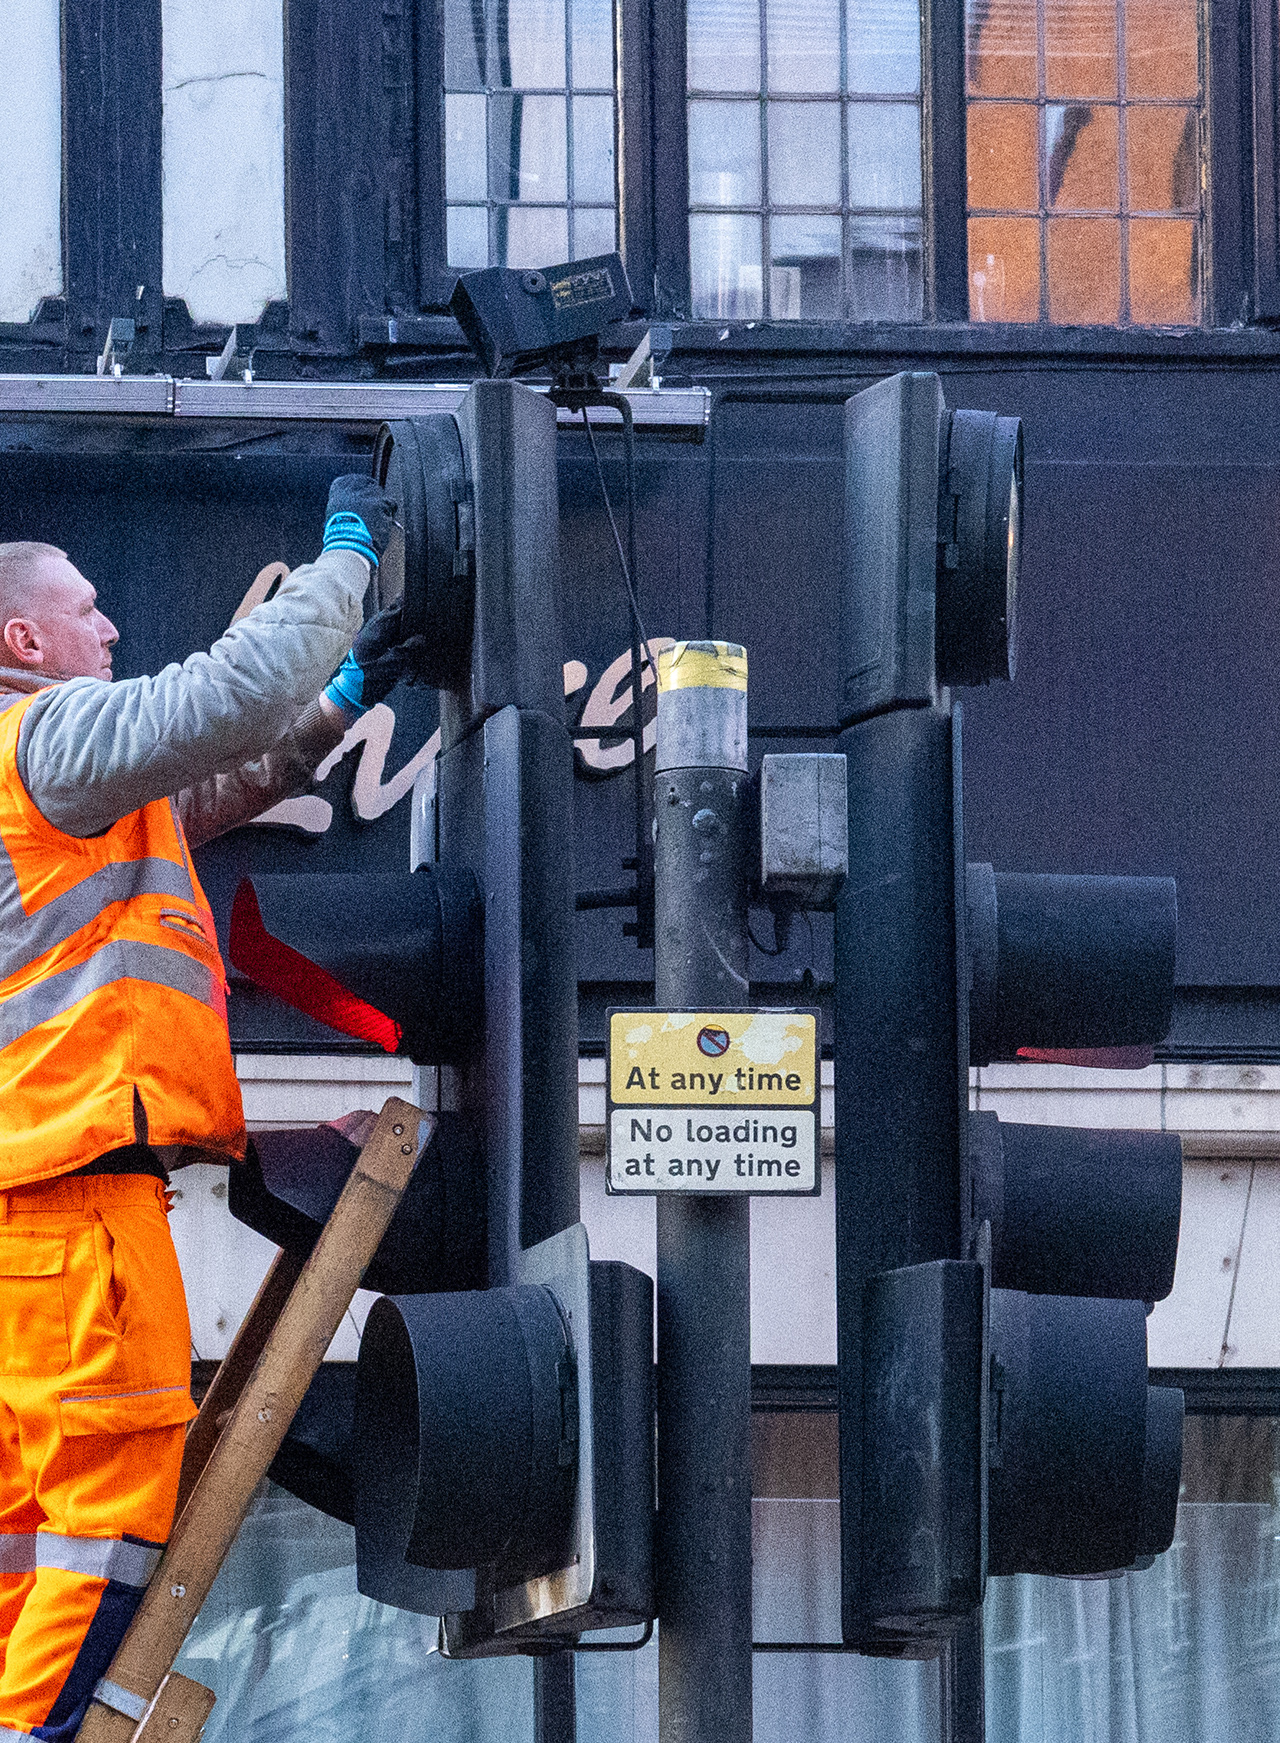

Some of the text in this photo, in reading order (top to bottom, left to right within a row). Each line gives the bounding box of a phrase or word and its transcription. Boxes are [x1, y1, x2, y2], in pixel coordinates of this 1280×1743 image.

[625, 1066, 801, 1095] At any time
[630, 1118, 797, 1148] No loading
[625, 1153, 801, 1181] at any time
